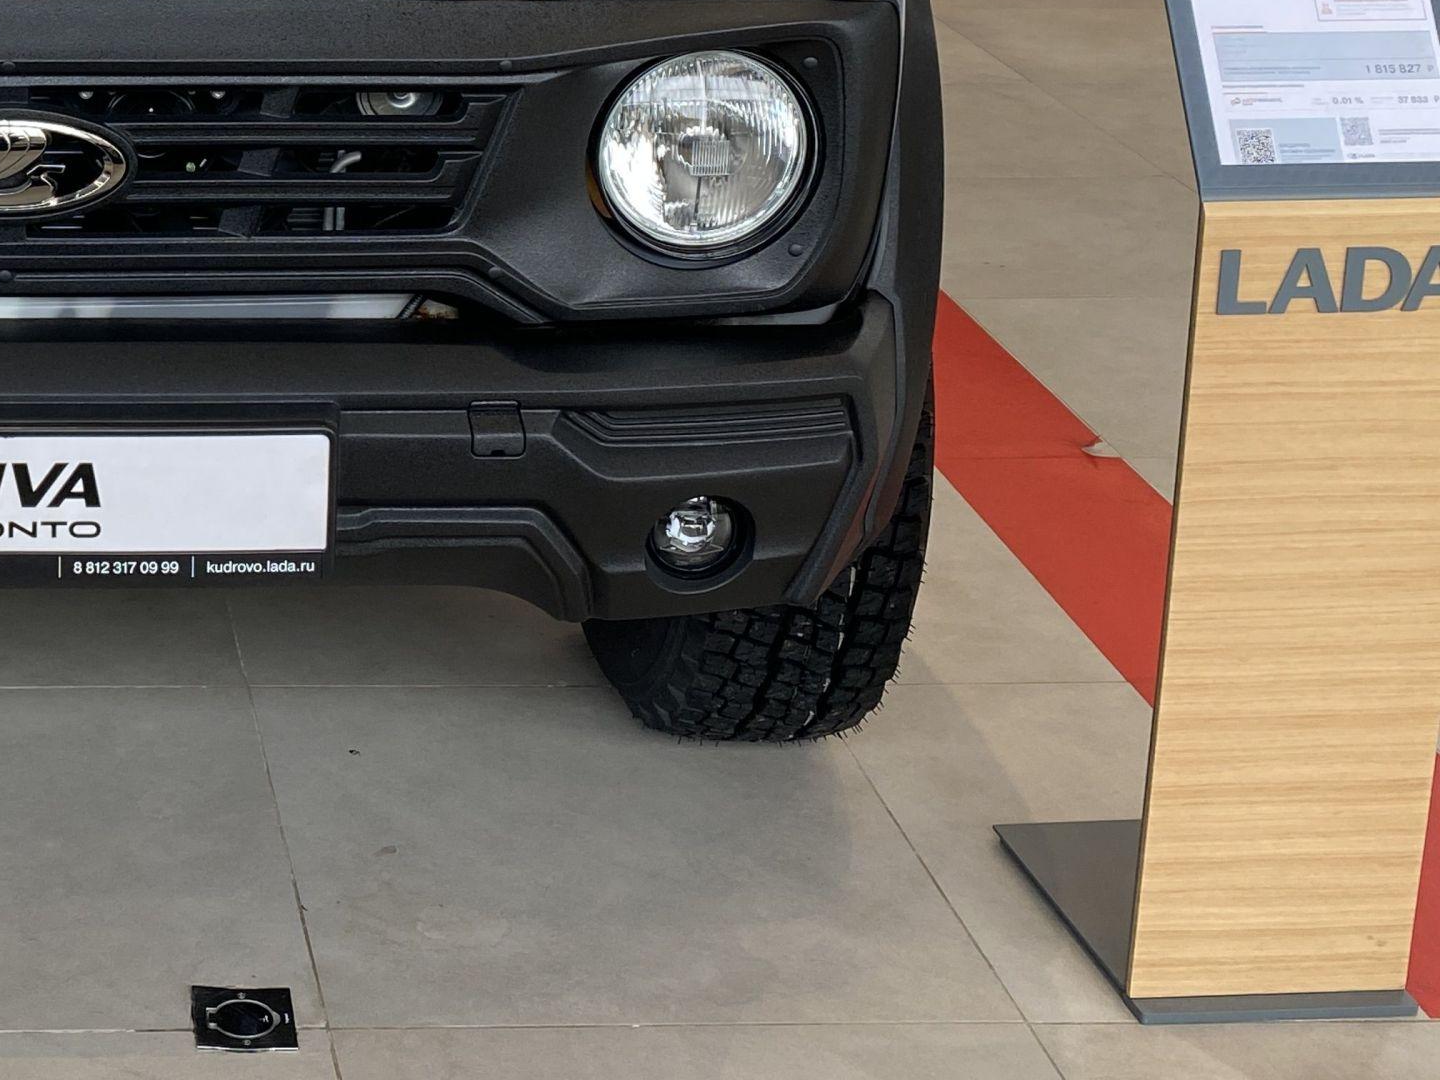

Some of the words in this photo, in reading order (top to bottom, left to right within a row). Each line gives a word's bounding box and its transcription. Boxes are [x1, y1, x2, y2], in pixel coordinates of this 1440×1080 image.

[1375, 64, 1396, 74] 815
[1399, 63, 1421, 74] 827
[1216, 245, 1440, 315] LADA
[73, 561, 82, 574] 8
[85, 561, 110, 574] 812
[113, 561, 137, 574] 317
[140, 561, 158, 574] 09
[161, 561, 179, 574] 99
[206, 560, 316, 573] kudrovo.lada.ru
